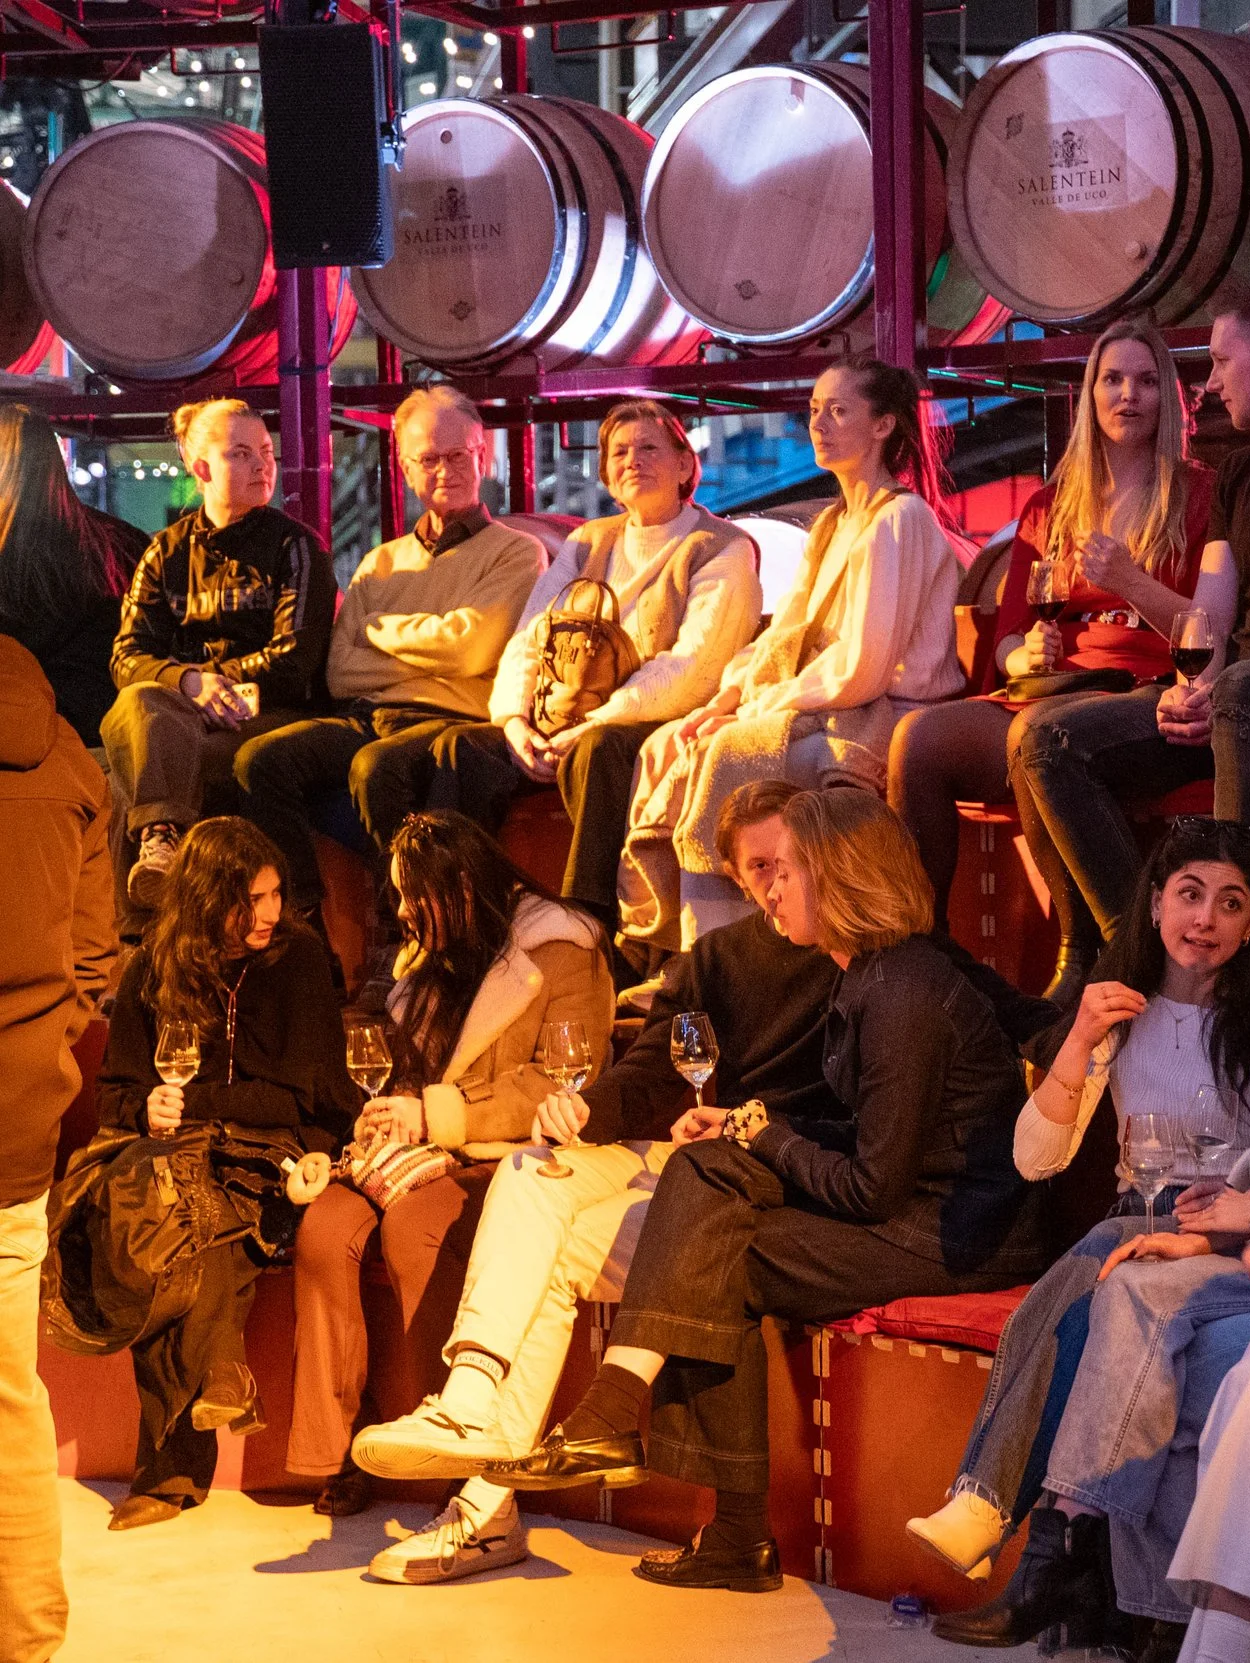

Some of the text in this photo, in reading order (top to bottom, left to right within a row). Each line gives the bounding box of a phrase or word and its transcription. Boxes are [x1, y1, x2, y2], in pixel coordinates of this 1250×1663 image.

[1018, 167, 1121, 195] SALENTEIN
[1032, 190, 1107, 206] VALLE DE UCO
[404, 223, 501, 245] SALENTEIN
